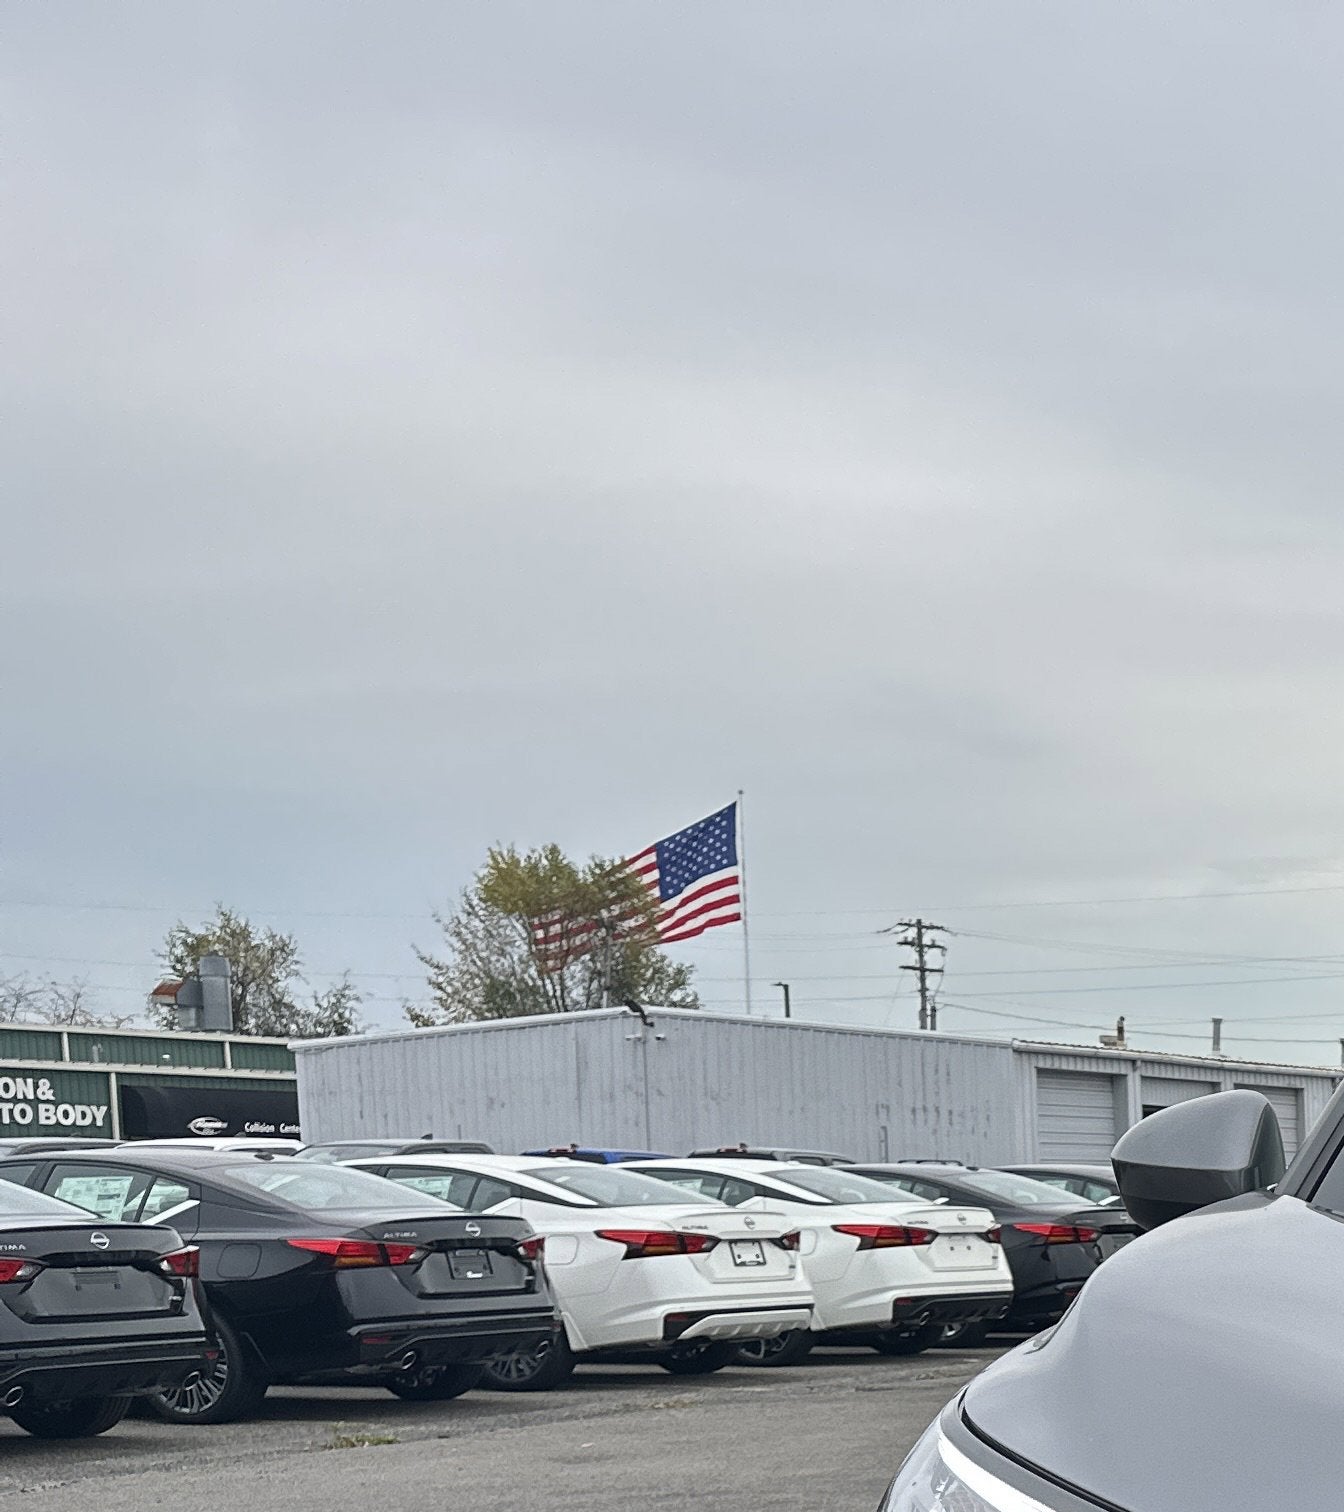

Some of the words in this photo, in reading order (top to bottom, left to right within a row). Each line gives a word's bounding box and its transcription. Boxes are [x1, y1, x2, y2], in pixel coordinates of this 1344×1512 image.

[0, 1077, 34, 1100] ON
[37, 1078, 56, 1100] &
[38, 1103, 108, 1127] BODY
